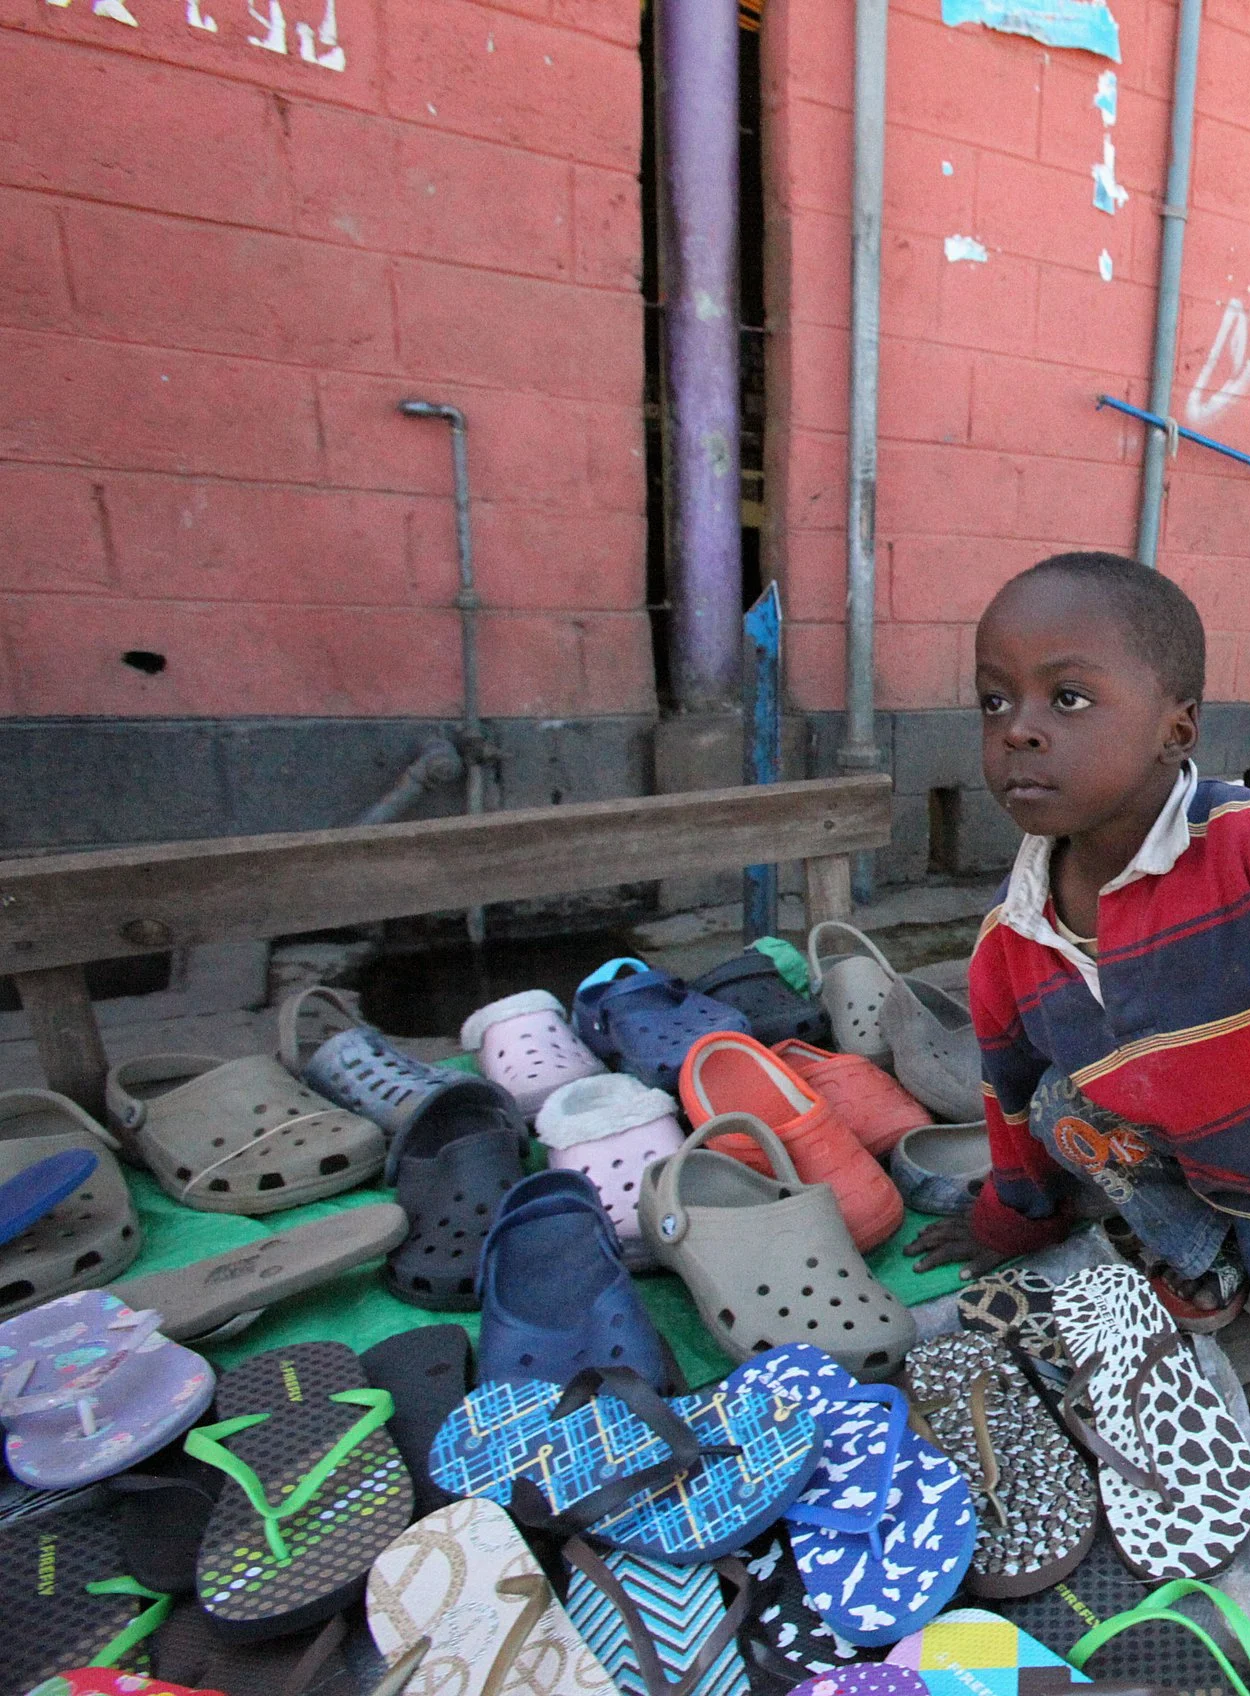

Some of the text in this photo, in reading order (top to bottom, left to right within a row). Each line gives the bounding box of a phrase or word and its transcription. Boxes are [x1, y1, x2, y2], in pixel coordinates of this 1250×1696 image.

[1094, 1294, 1121, 1335] FIREFLY
[281, 1366, 304, 1402] FIREFLY
[37, 1544, 57, 1596] FIREFLY
[1054, 1583, 1101, 1628] FIREFLY
